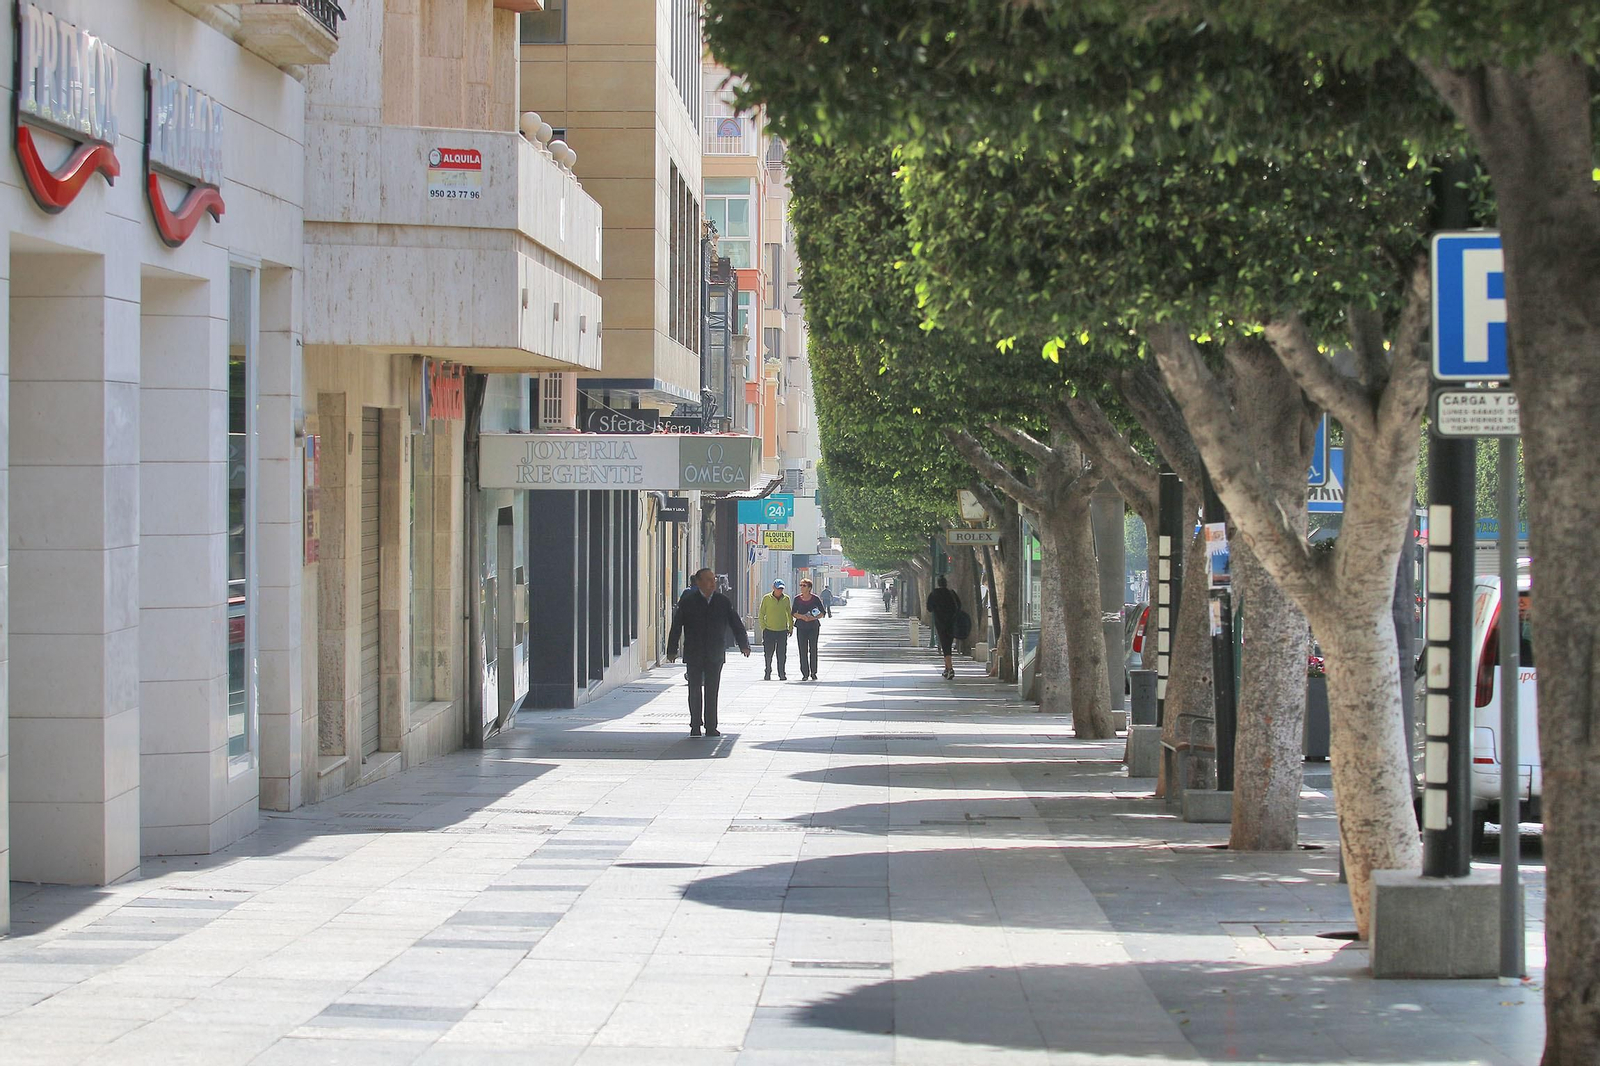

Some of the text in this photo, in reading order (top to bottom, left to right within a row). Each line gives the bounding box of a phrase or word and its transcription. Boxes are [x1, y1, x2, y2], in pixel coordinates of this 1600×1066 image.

[444, 154, 480, 164] ALQUILA
[430, 189, 480, 199] 950 23 77 96
[1443, 396, 1486, 405] CARGA
[1494, 396, 1501, 405] Y
[521, 441, 637, 464] JOYERIA
[516, 465, 643, 484] REGENTE
[684, 464, 746, 483] OMEGA
